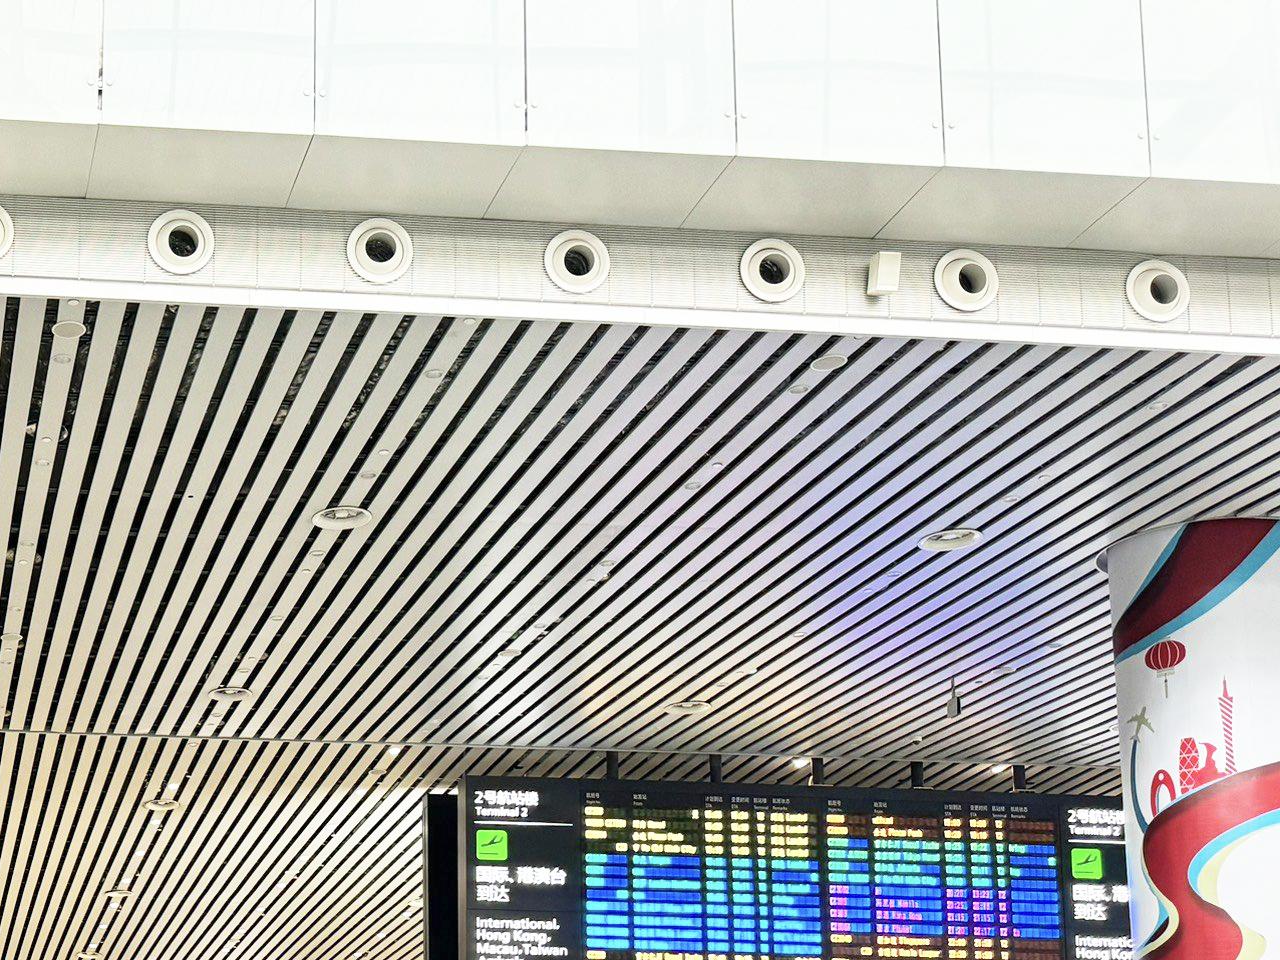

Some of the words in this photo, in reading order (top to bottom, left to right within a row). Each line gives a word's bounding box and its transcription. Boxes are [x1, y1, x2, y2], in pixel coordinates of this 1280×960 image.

[475, 806, 519, 818] Terminal
[520, 808, 529, 818] 2
[1069, 824, 1111, 836] Terminal
[1112, 826, 1121, 836] 2
[476, 885, 510, 902] 到达
[1072, 884, 1129, 903] 国际、港
[1073, 903, 1108, 921] 到达
[476, 916, 560, 930] International,
[476, 930, 510, 943] Hong
[513, 930, 551, 944] Kong,
[1075, 935, 1134, 949] Internatio
[1111, 949, 1134, 960] Kon
